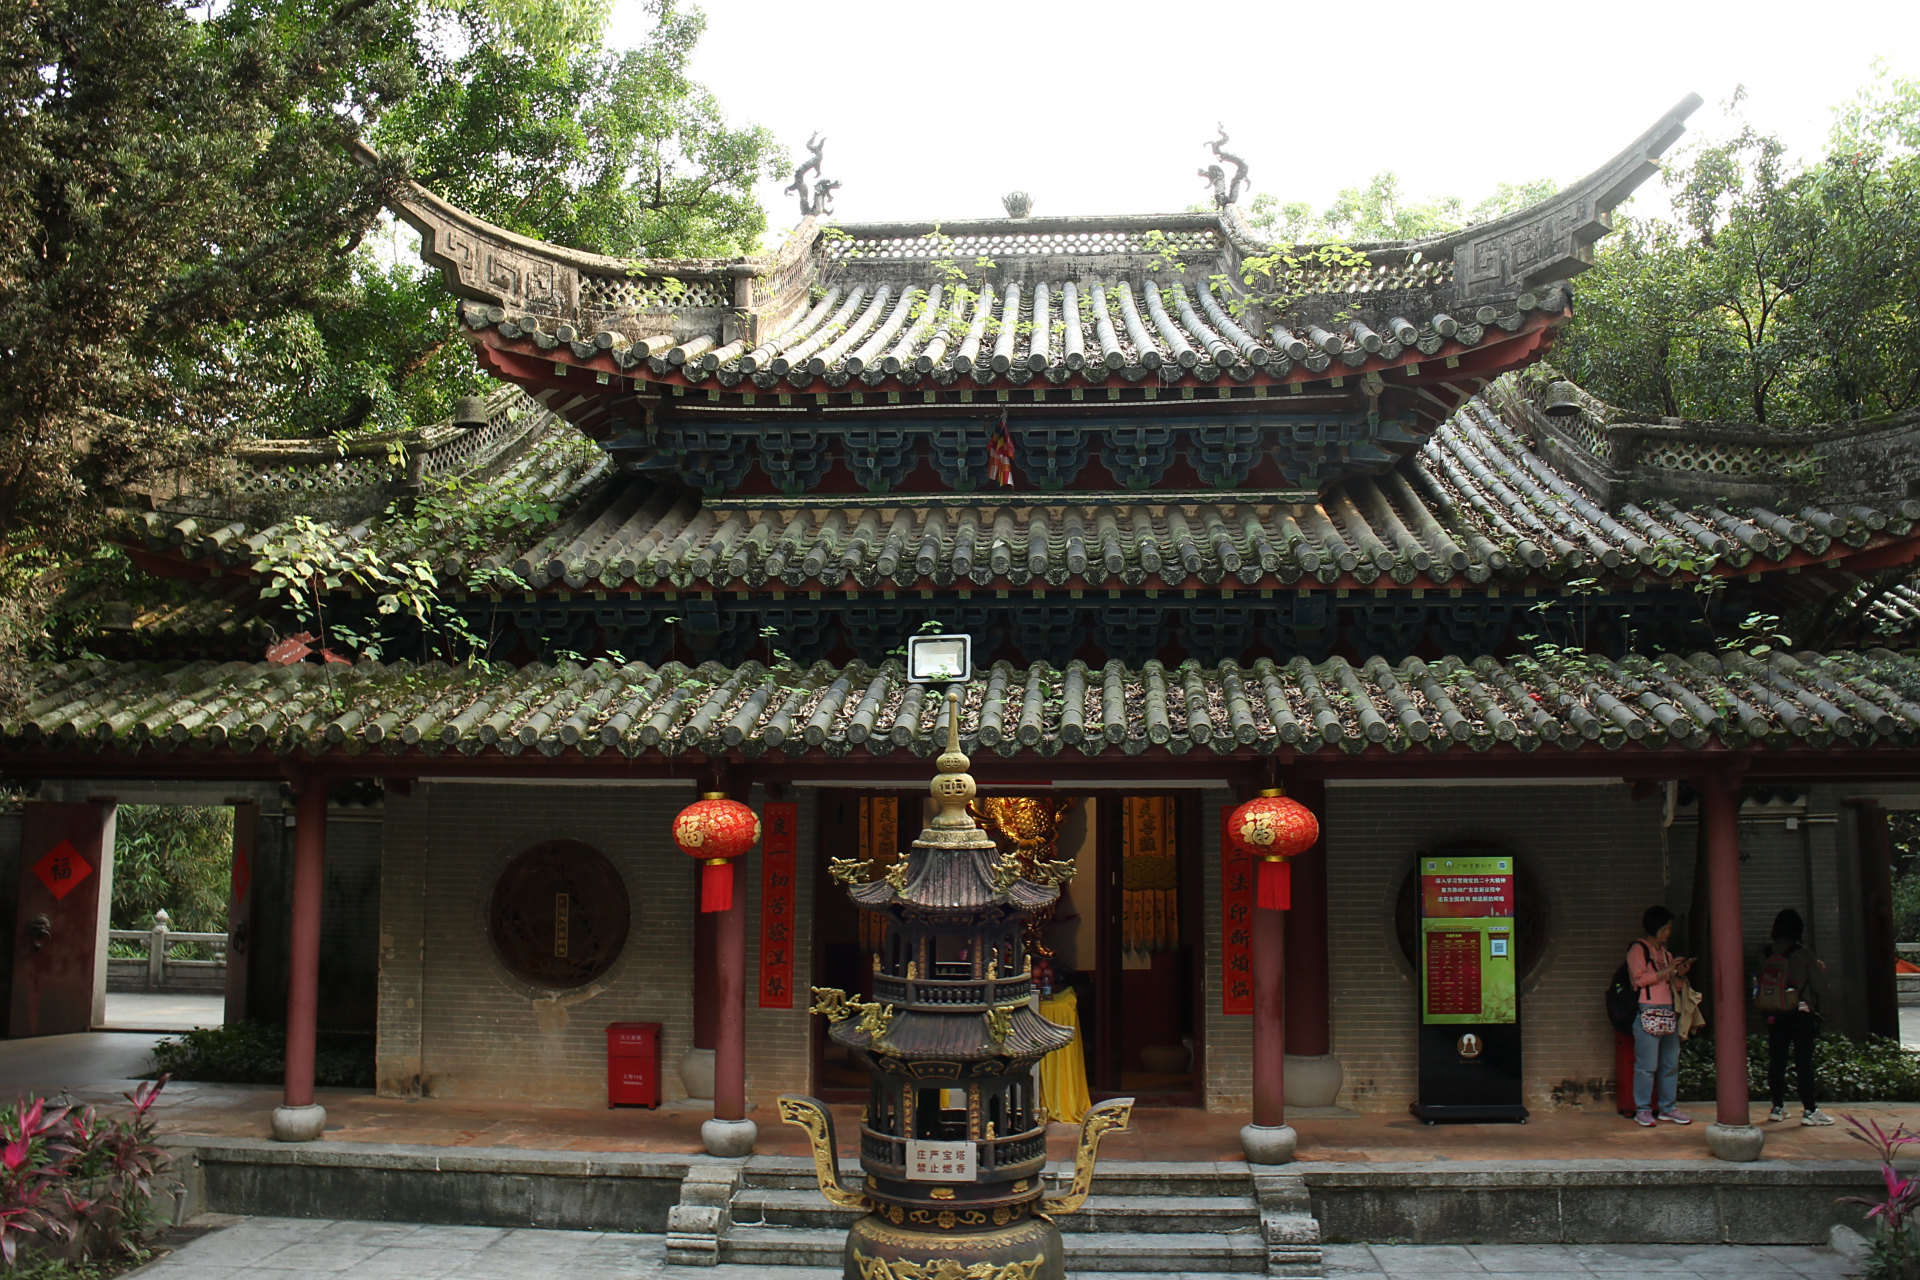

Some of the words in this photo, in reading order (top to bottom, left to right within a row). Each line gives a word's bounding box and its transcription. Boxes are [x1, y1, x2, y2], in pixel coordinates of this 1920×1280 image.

[51, 857, 72, 882] 福
[917, 1149, 966, 1161] 庄严宝塔
[917, 1163, 966, 1174] 禁止燃香
